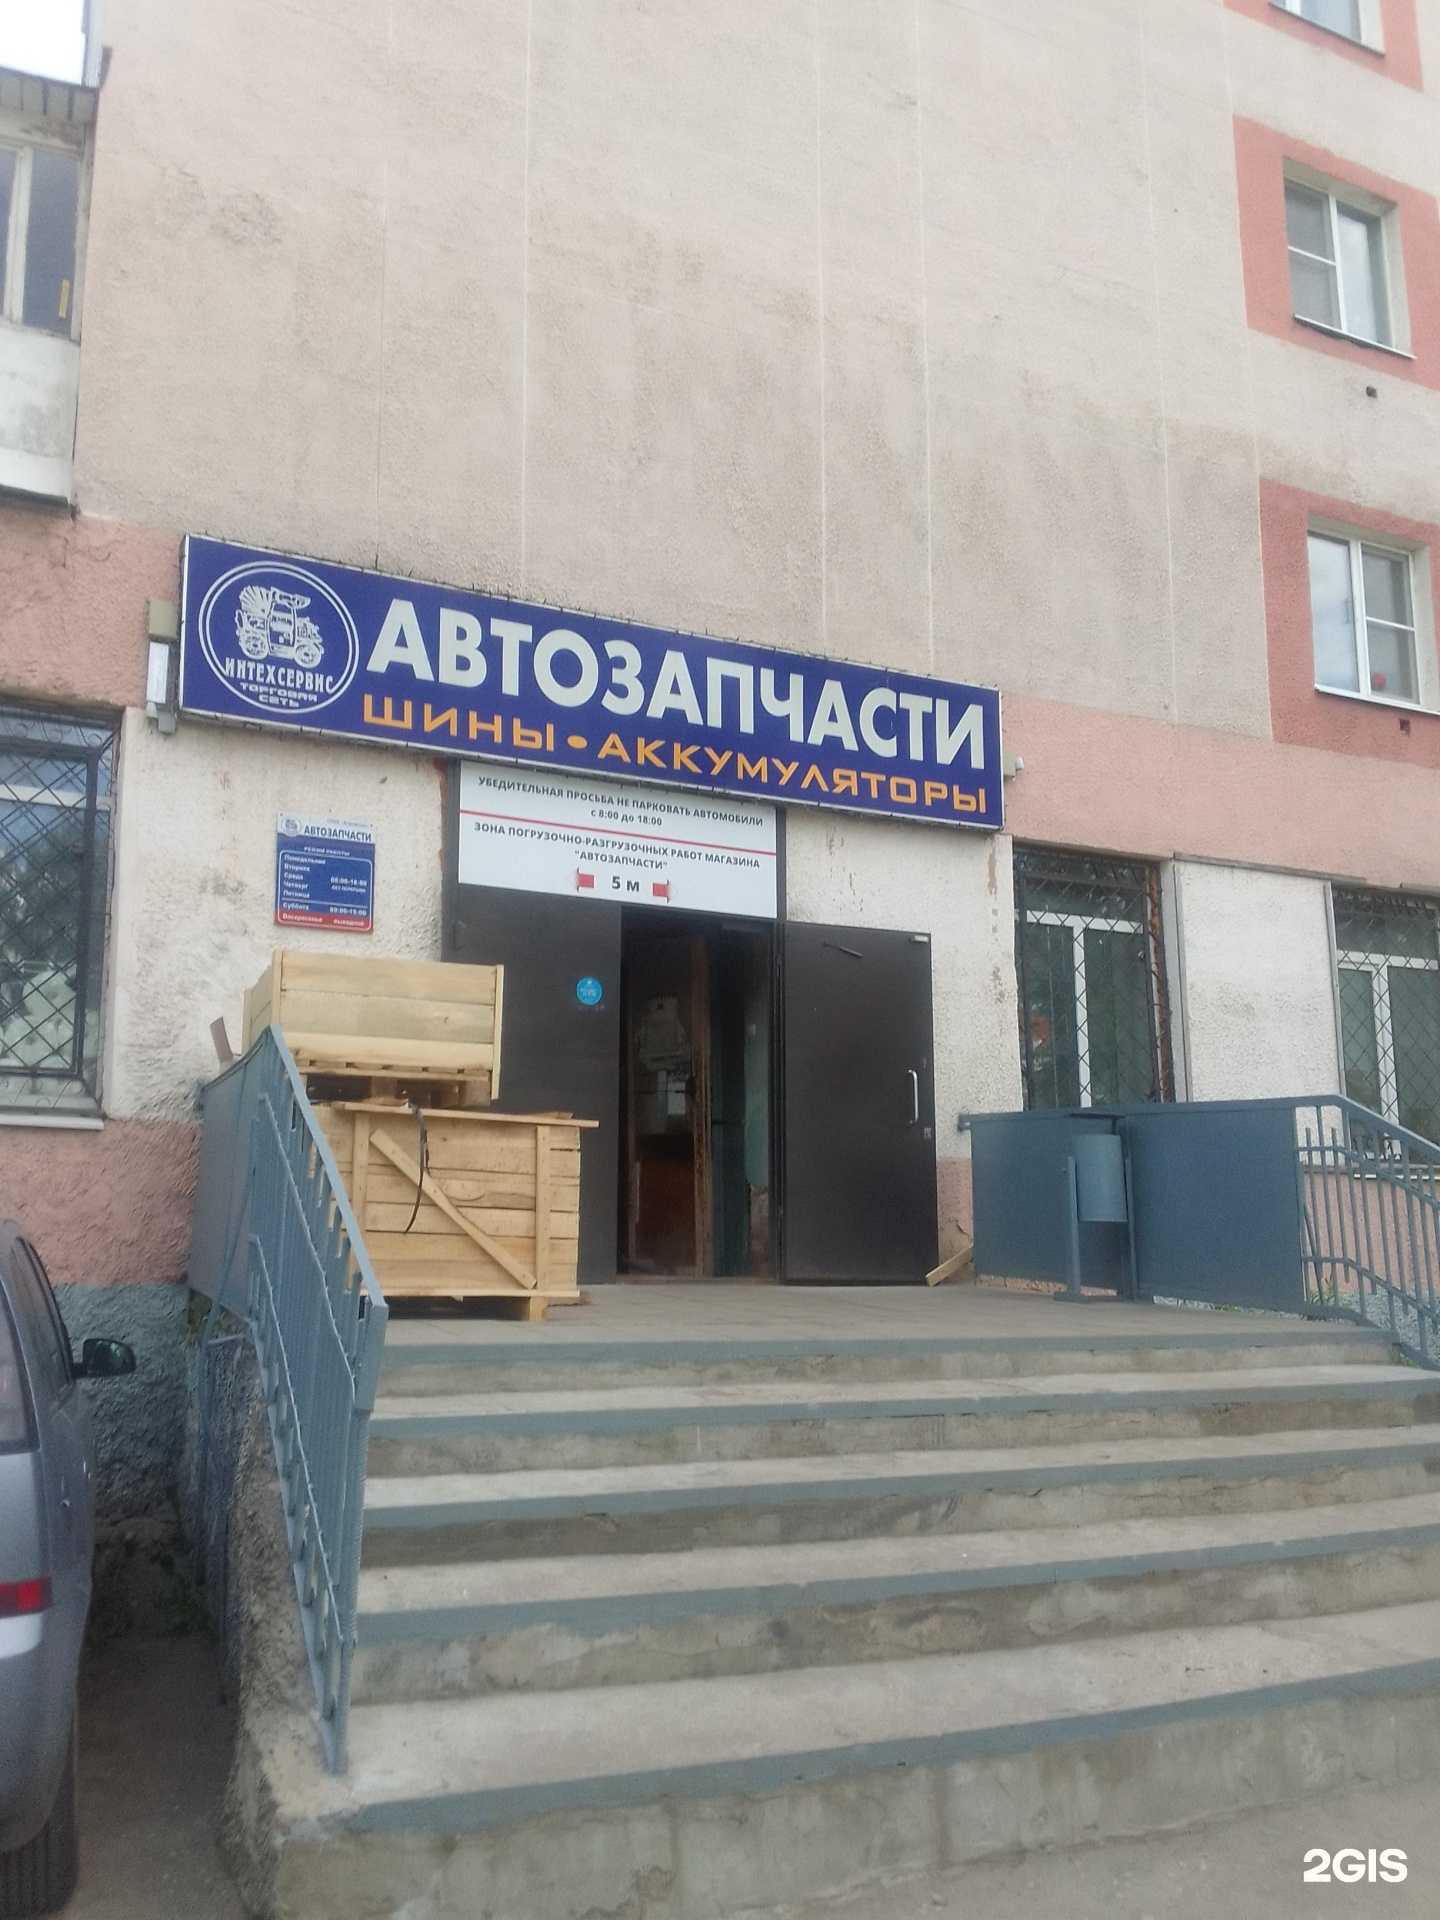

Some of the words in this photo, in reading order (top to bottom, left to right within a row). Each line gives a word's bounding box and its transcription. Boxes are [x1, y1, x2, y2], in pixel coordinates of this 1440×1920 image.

[225, 657, 334, 694] ИНТЕХСЕРВИС
[366, 599, 984, 769] АВТОЗАПЧАСТИ
[364, 693, 554, 752] ШИНЫ
[598, 733, 987, 814] АККУМУЛЯТОРЫ
[478, 776, 563, 798] УБЕДИТЕЛЬНАЯ
[566, 790, 614, 806] ПРОСЬБА
[616, 796, 630, 808] НЕ
[632, 799, 691, 817] ПАРКОВАТЬ
[693, 808, 763, 827] АВТОМОБИЛИ
[598, 808, 619, 821] 8:00
[621, 814, 634, 824] до
[637, 814, 663, 826] 18:00
[304, 825, 372, 841] АВТОЗАПЧАСТИ
[474, 822, 506, 836] ЗОНА
[508, 826, 668, 857] ПОГРУЗОЧНО-РАЗГРУЗОЧНЫХ
[671, 848, 702, 862] РАБОТ
[705, 853, 760, 869] МАГАЗИНА
[574, 850, 668, 870] "АВТОЗАПЧАСТИ"
[611, 876, 621, 890] 5
